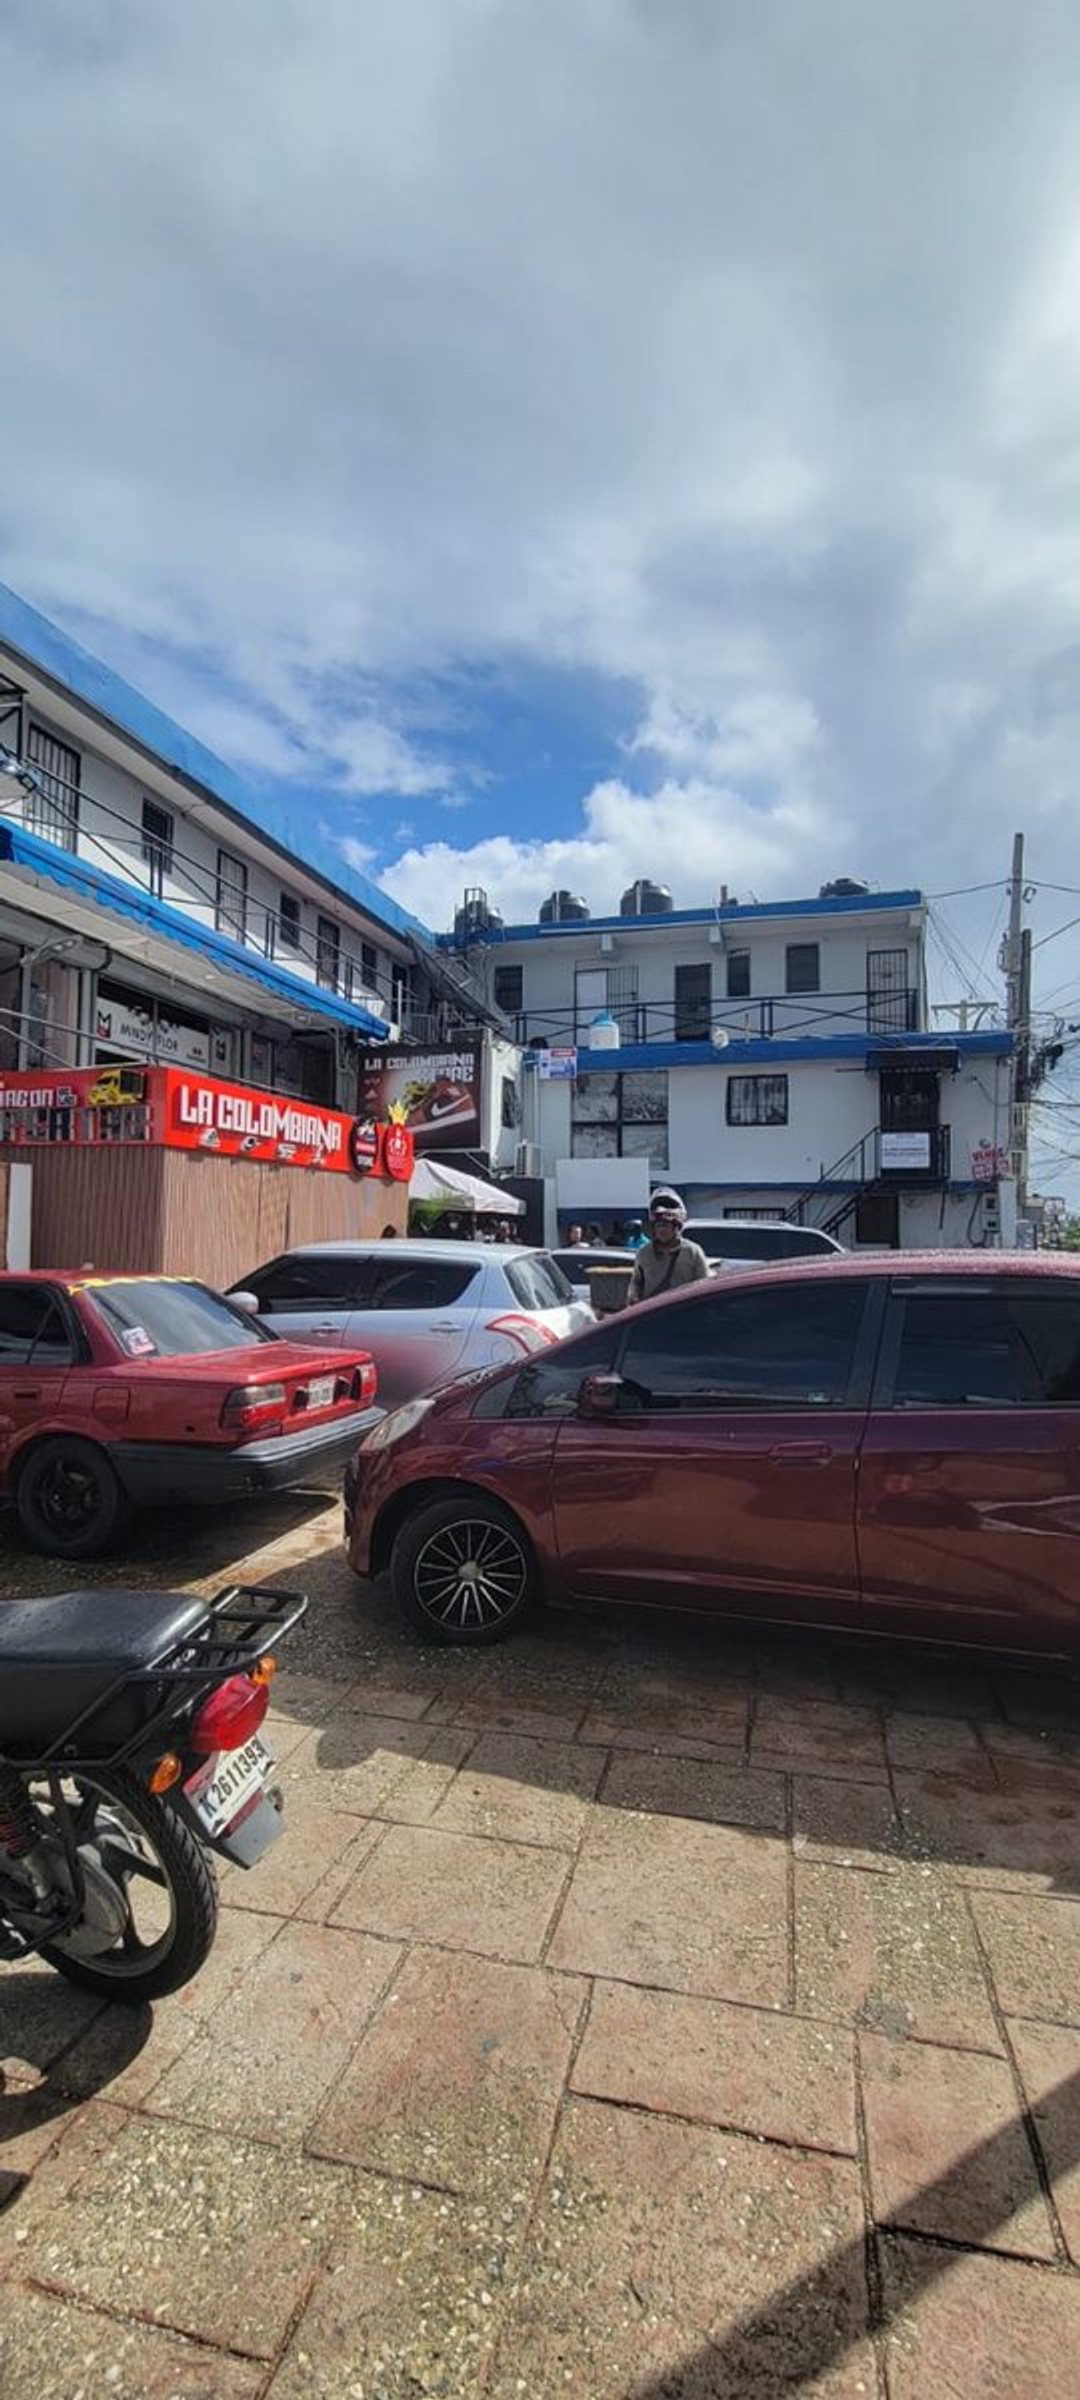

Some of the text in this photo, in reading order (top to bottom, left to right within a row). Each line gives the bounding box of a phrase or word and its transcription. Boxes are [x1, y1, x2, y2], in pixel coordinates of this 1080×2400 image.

[365, 1052, 476, 1071] LA COLOMBIANA
[180, 1085, 342, 1152] LA COLOMBIANA
